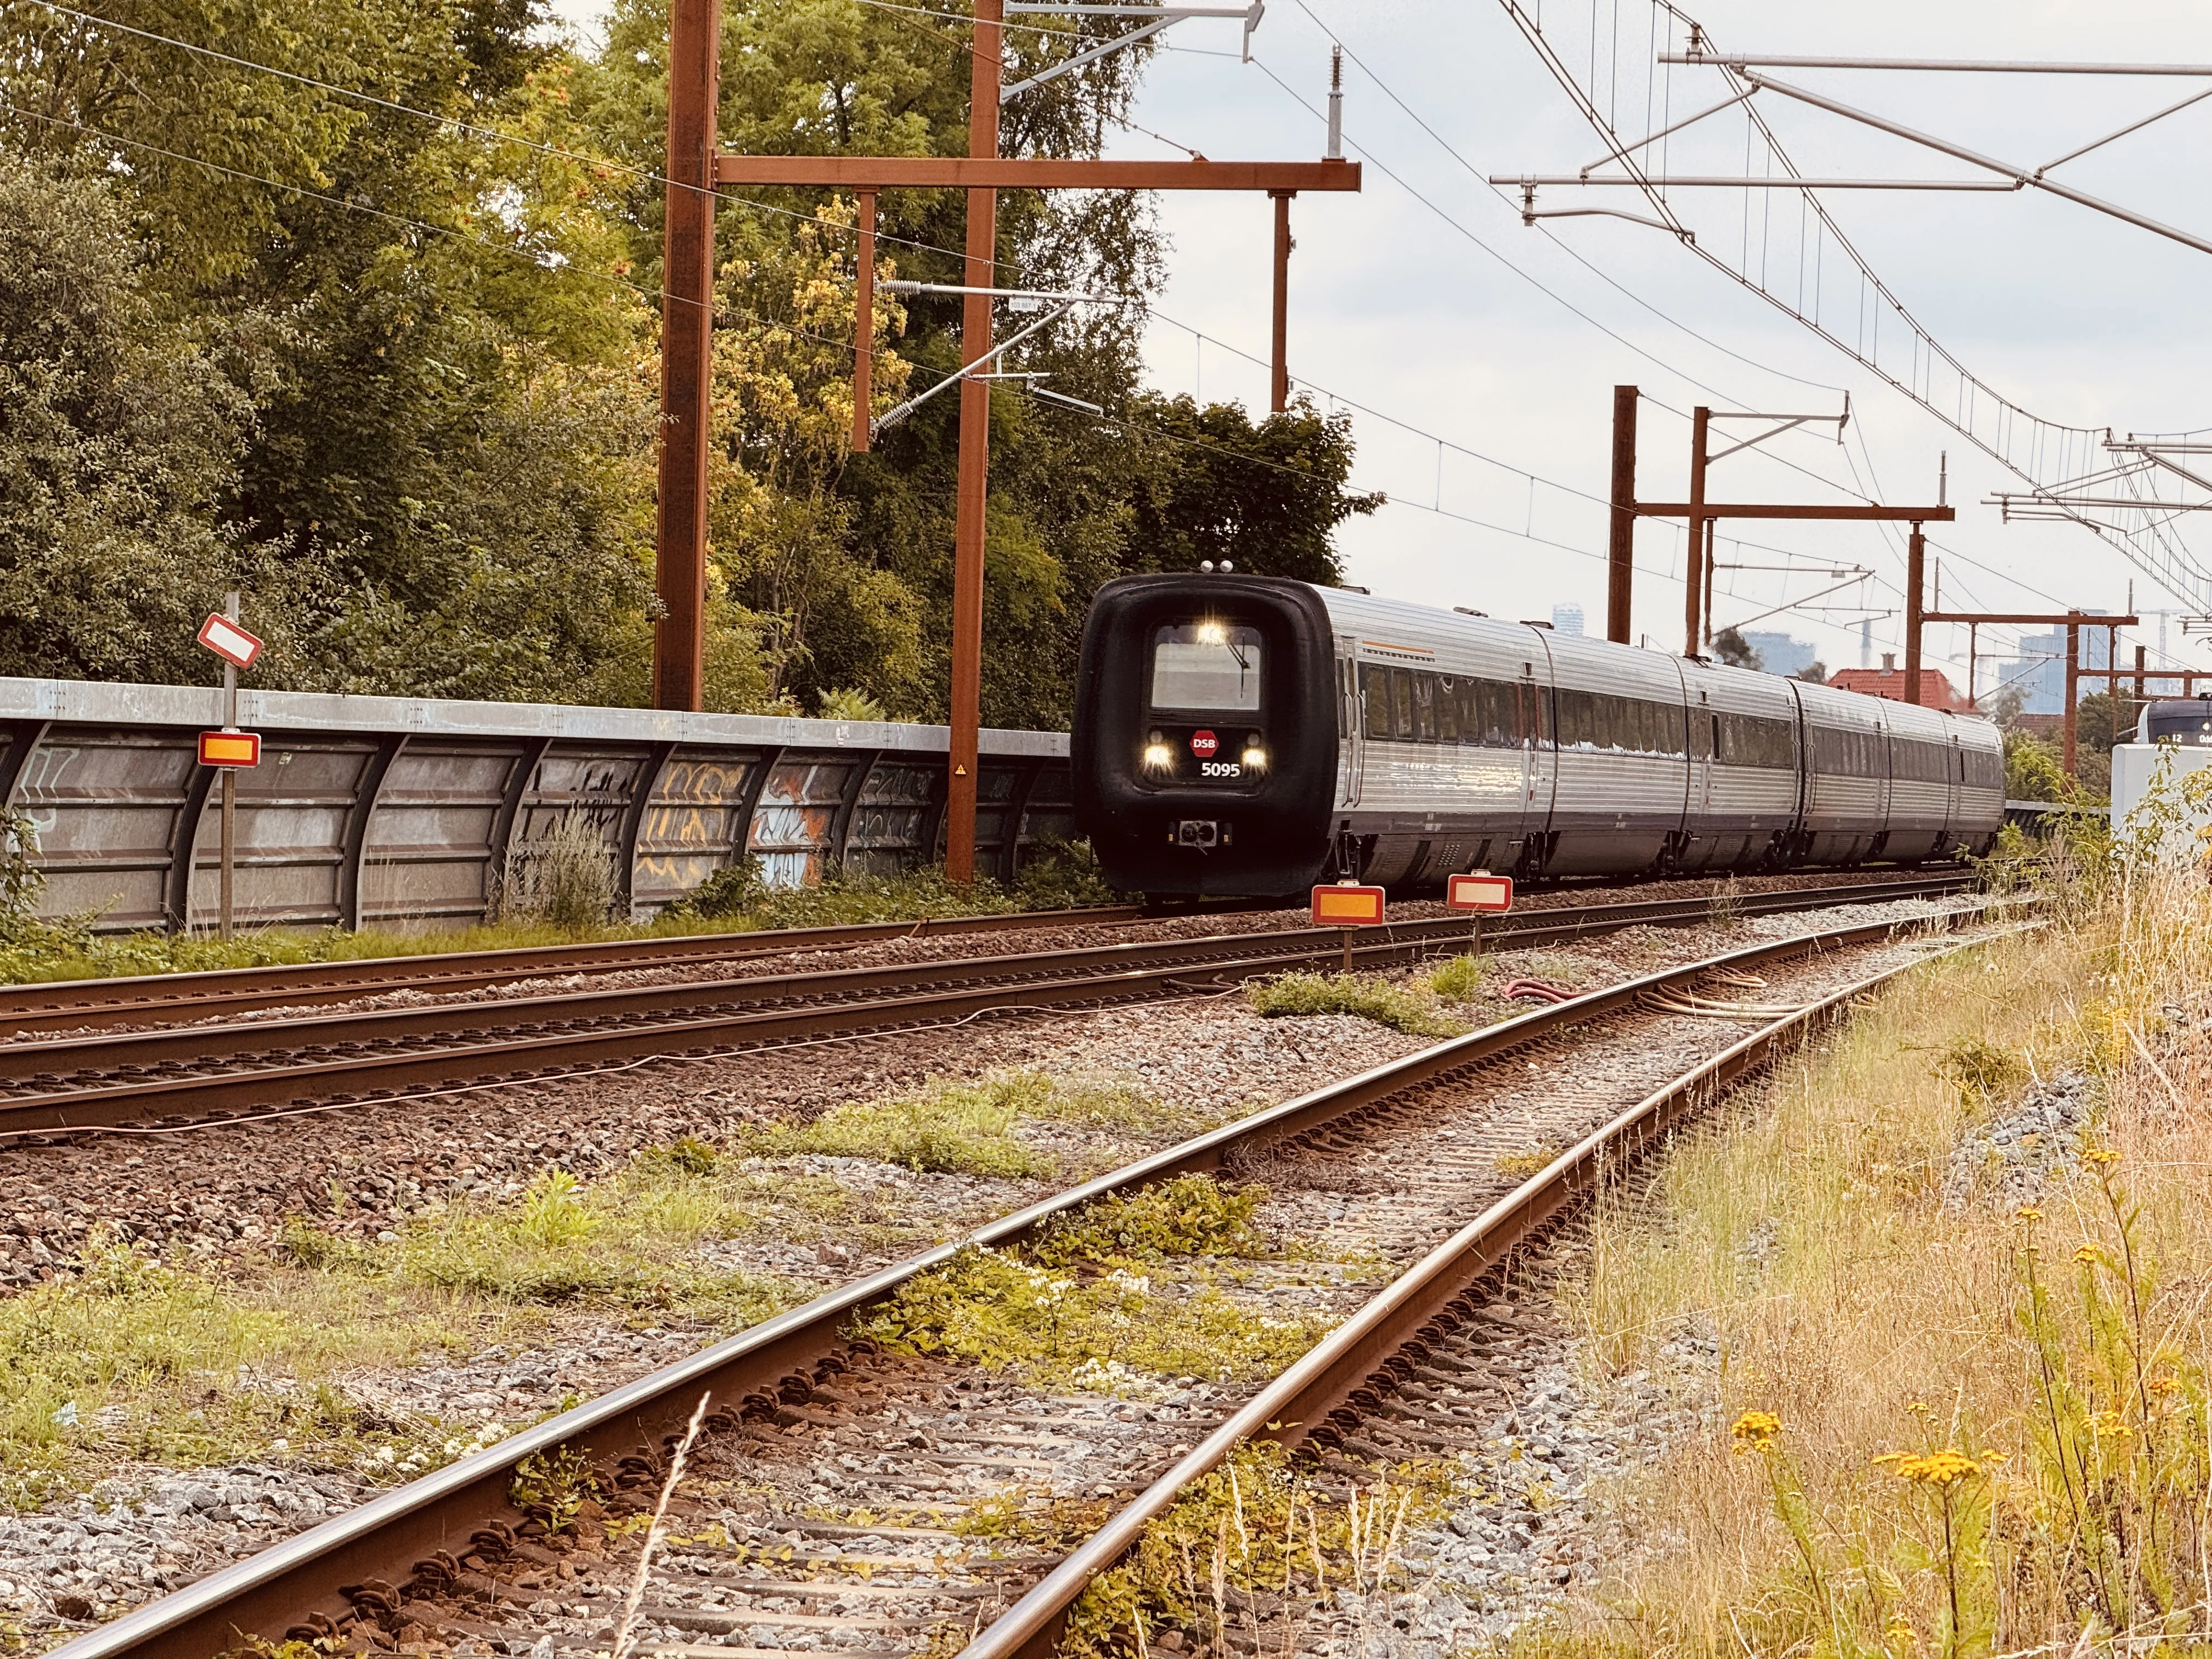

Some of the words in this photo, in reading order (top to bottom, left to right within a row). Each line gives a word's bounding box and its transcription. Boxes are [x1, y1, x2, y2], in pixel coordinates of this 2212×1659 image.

[2172, 733, 2182, 742] 12
[1193, 738, 1216, 748] DSB
[1201, 763, 1240, 777] 5095
